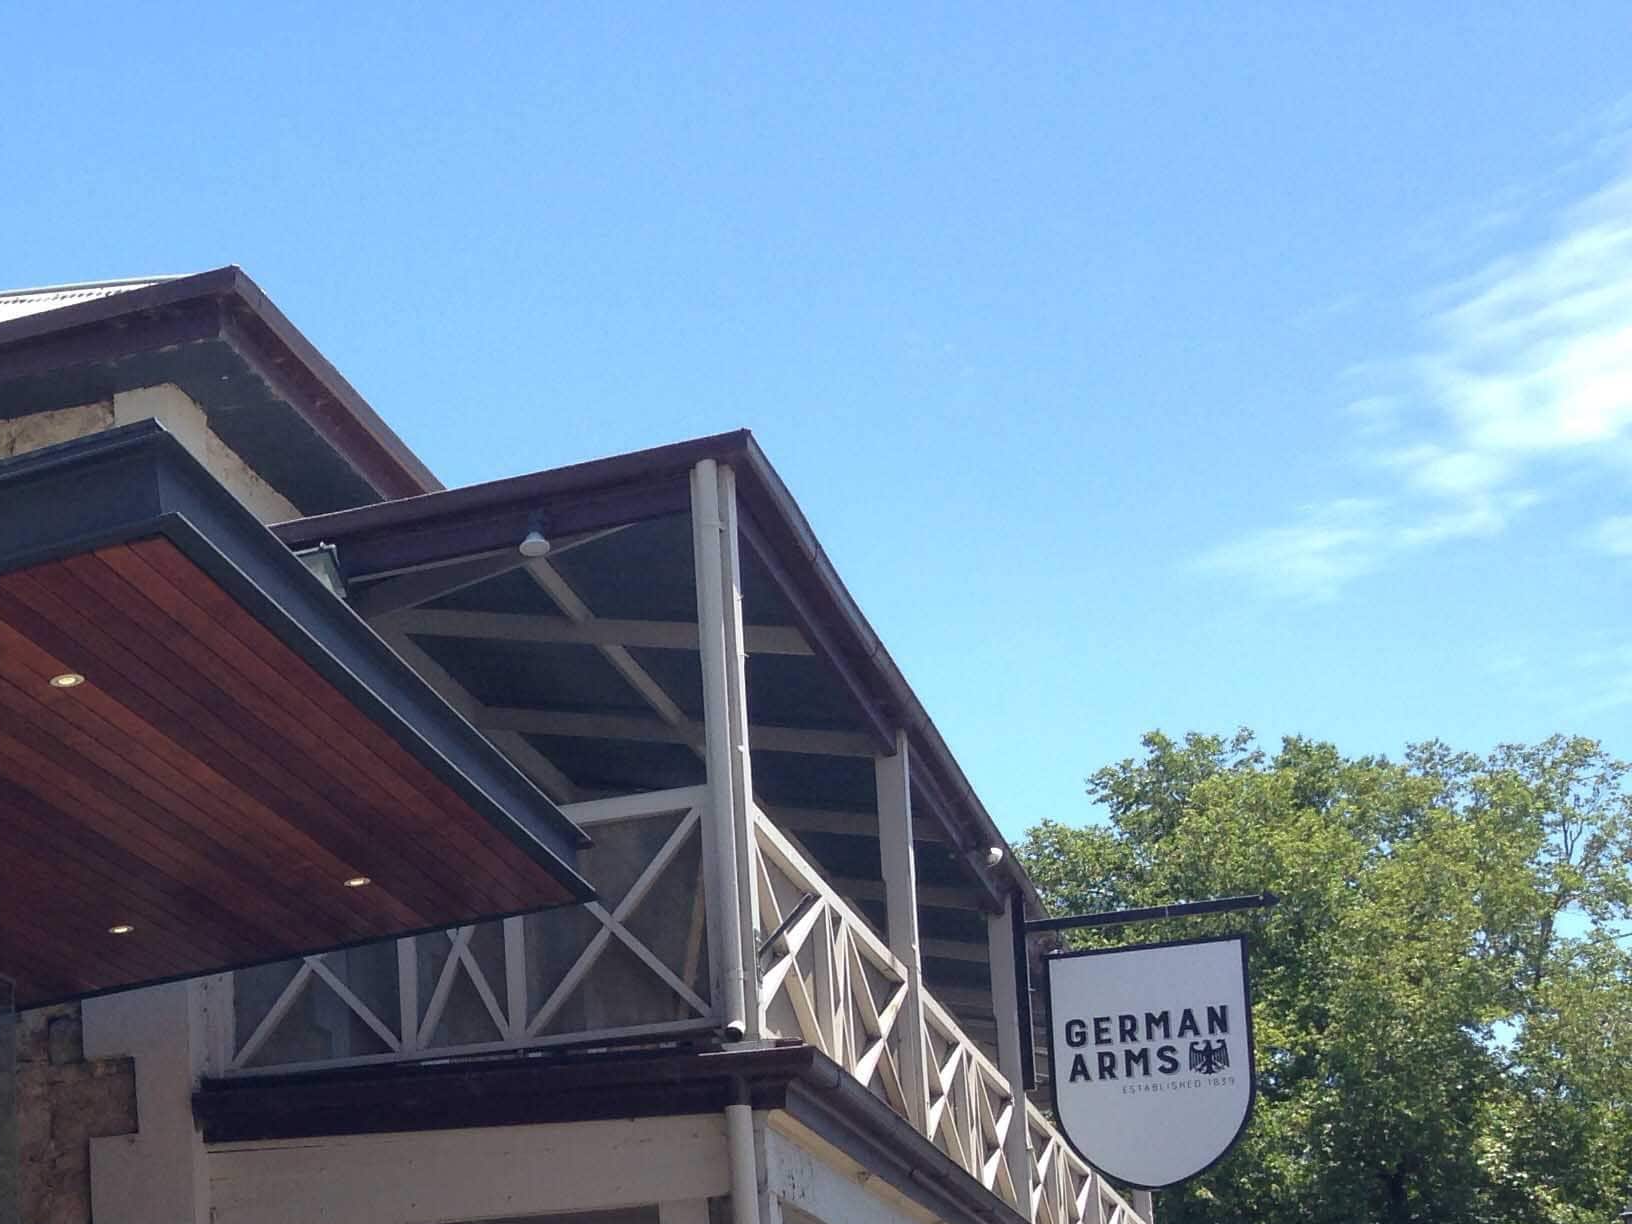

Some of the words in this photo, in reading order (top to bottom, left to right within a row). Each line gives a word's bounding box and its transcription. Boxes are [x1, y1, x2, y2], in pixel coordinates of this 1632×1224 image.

[1064, 1004, 1229, 1048] GERMAN
[1069, 1045, 1180, 1083] ARMS
[1122, 1078, 1202, 1094] ESTABLISHED
